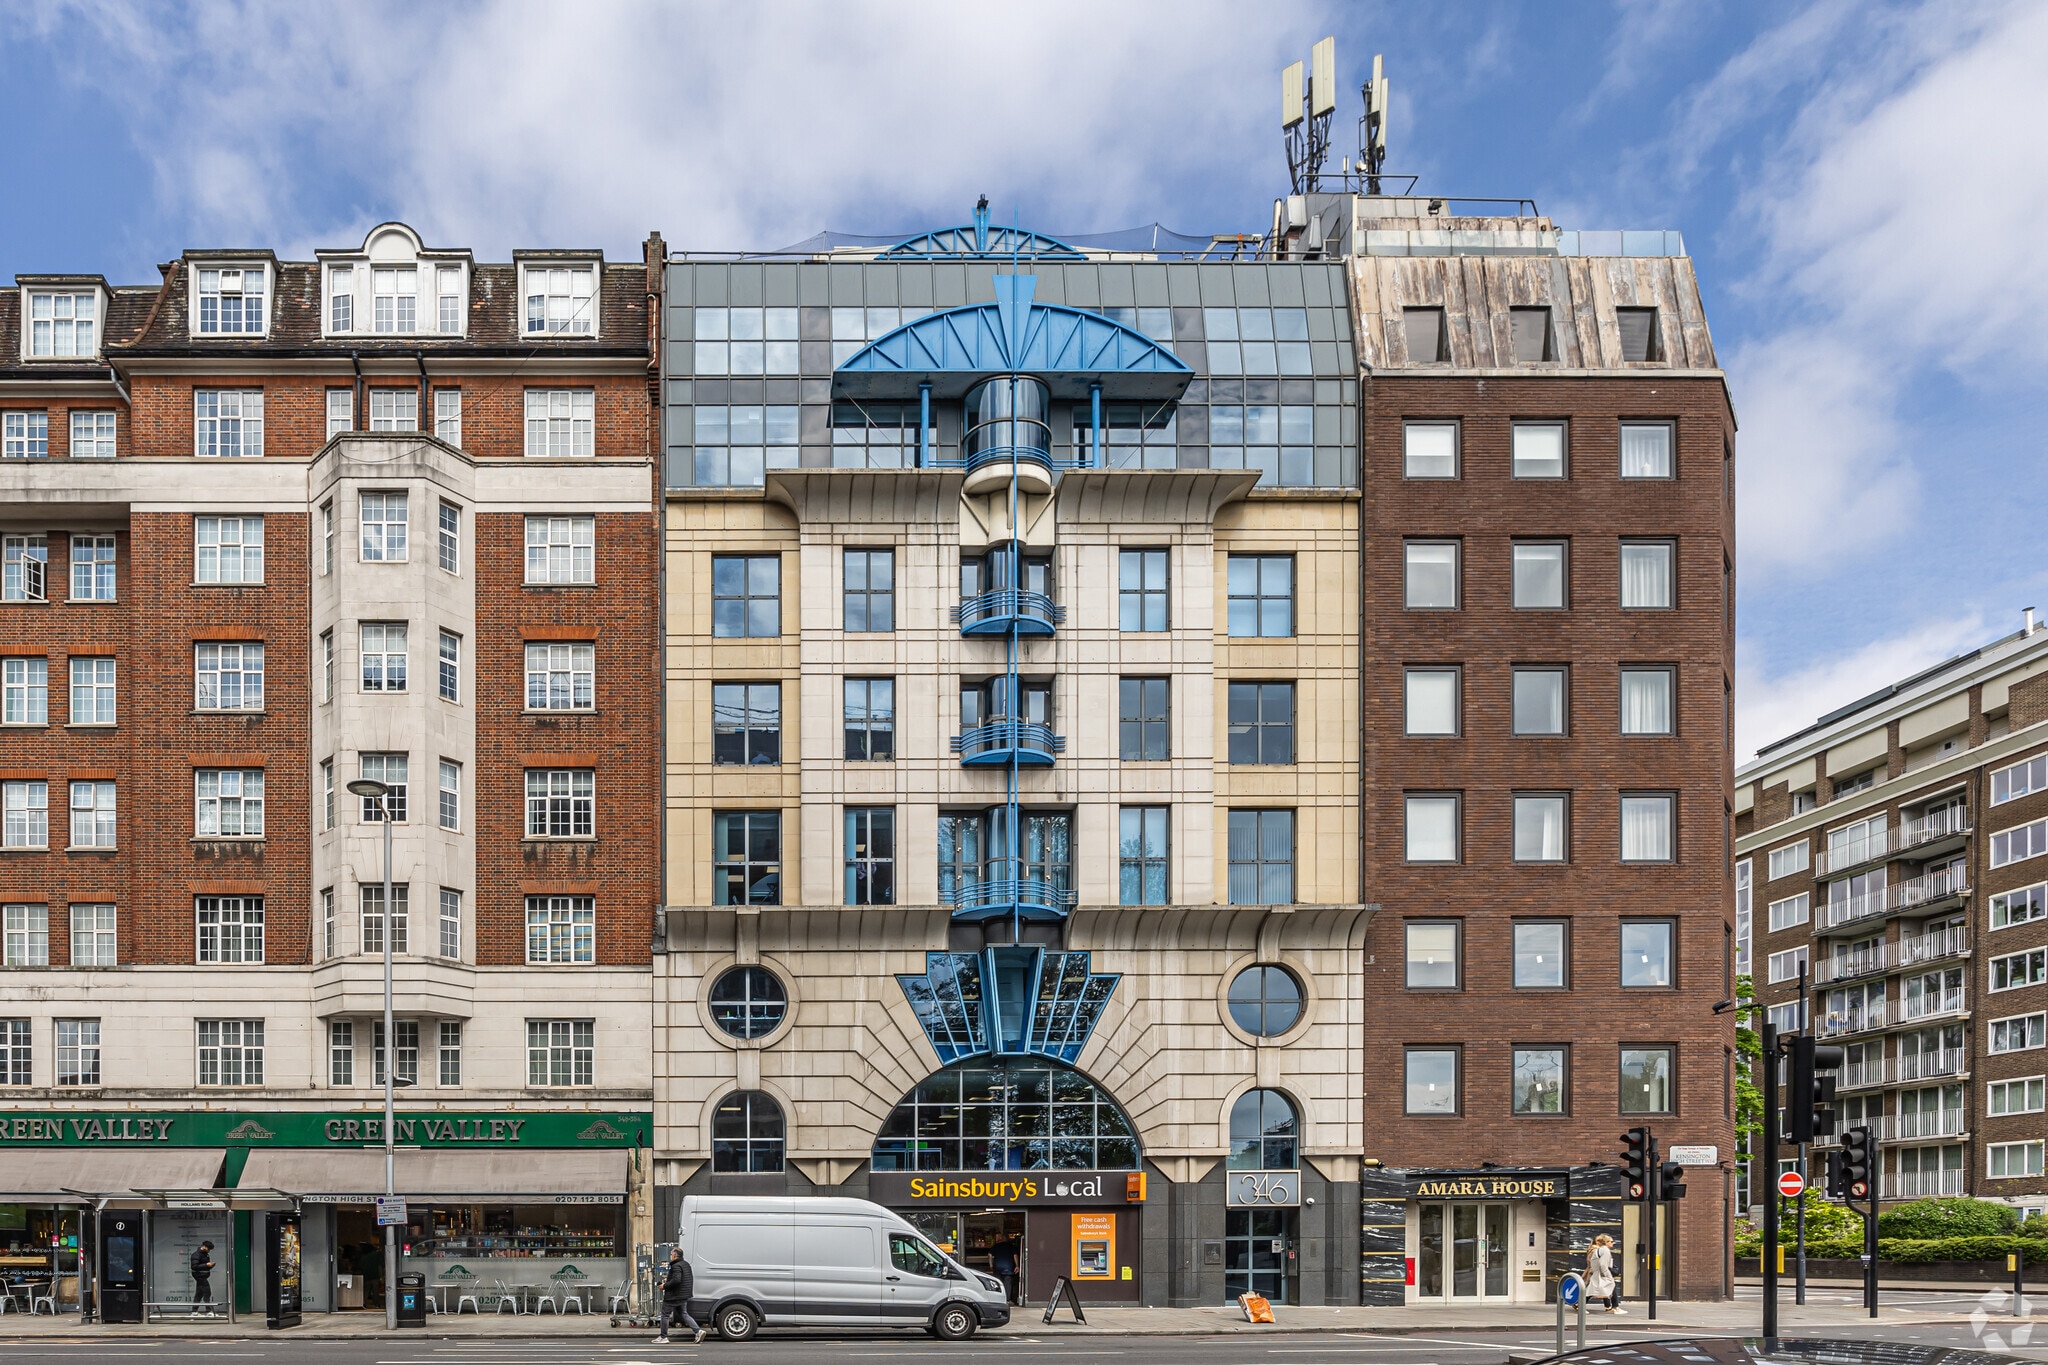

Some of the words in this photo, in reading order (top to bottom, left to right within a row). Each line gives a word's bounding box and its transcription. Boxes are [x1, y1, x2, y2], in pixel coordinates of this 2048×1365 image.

[0, 1118, 65, 1140] REEN
[70, 1118, 174, 1140] VALLEY
[421, 1119, 525, 1141] VALLEY
[910, 1177, 1037, 1201] Sainsbury's
[1044, 1176, 1102, 1197] Local
[1239, 1173, 1288, 1204] 346
[1417, 1182, 1487, 1196] AMARA
[1491, 1181, 1555, 1195] HOUSE
[478, 1296, 501, 1304] 0207
